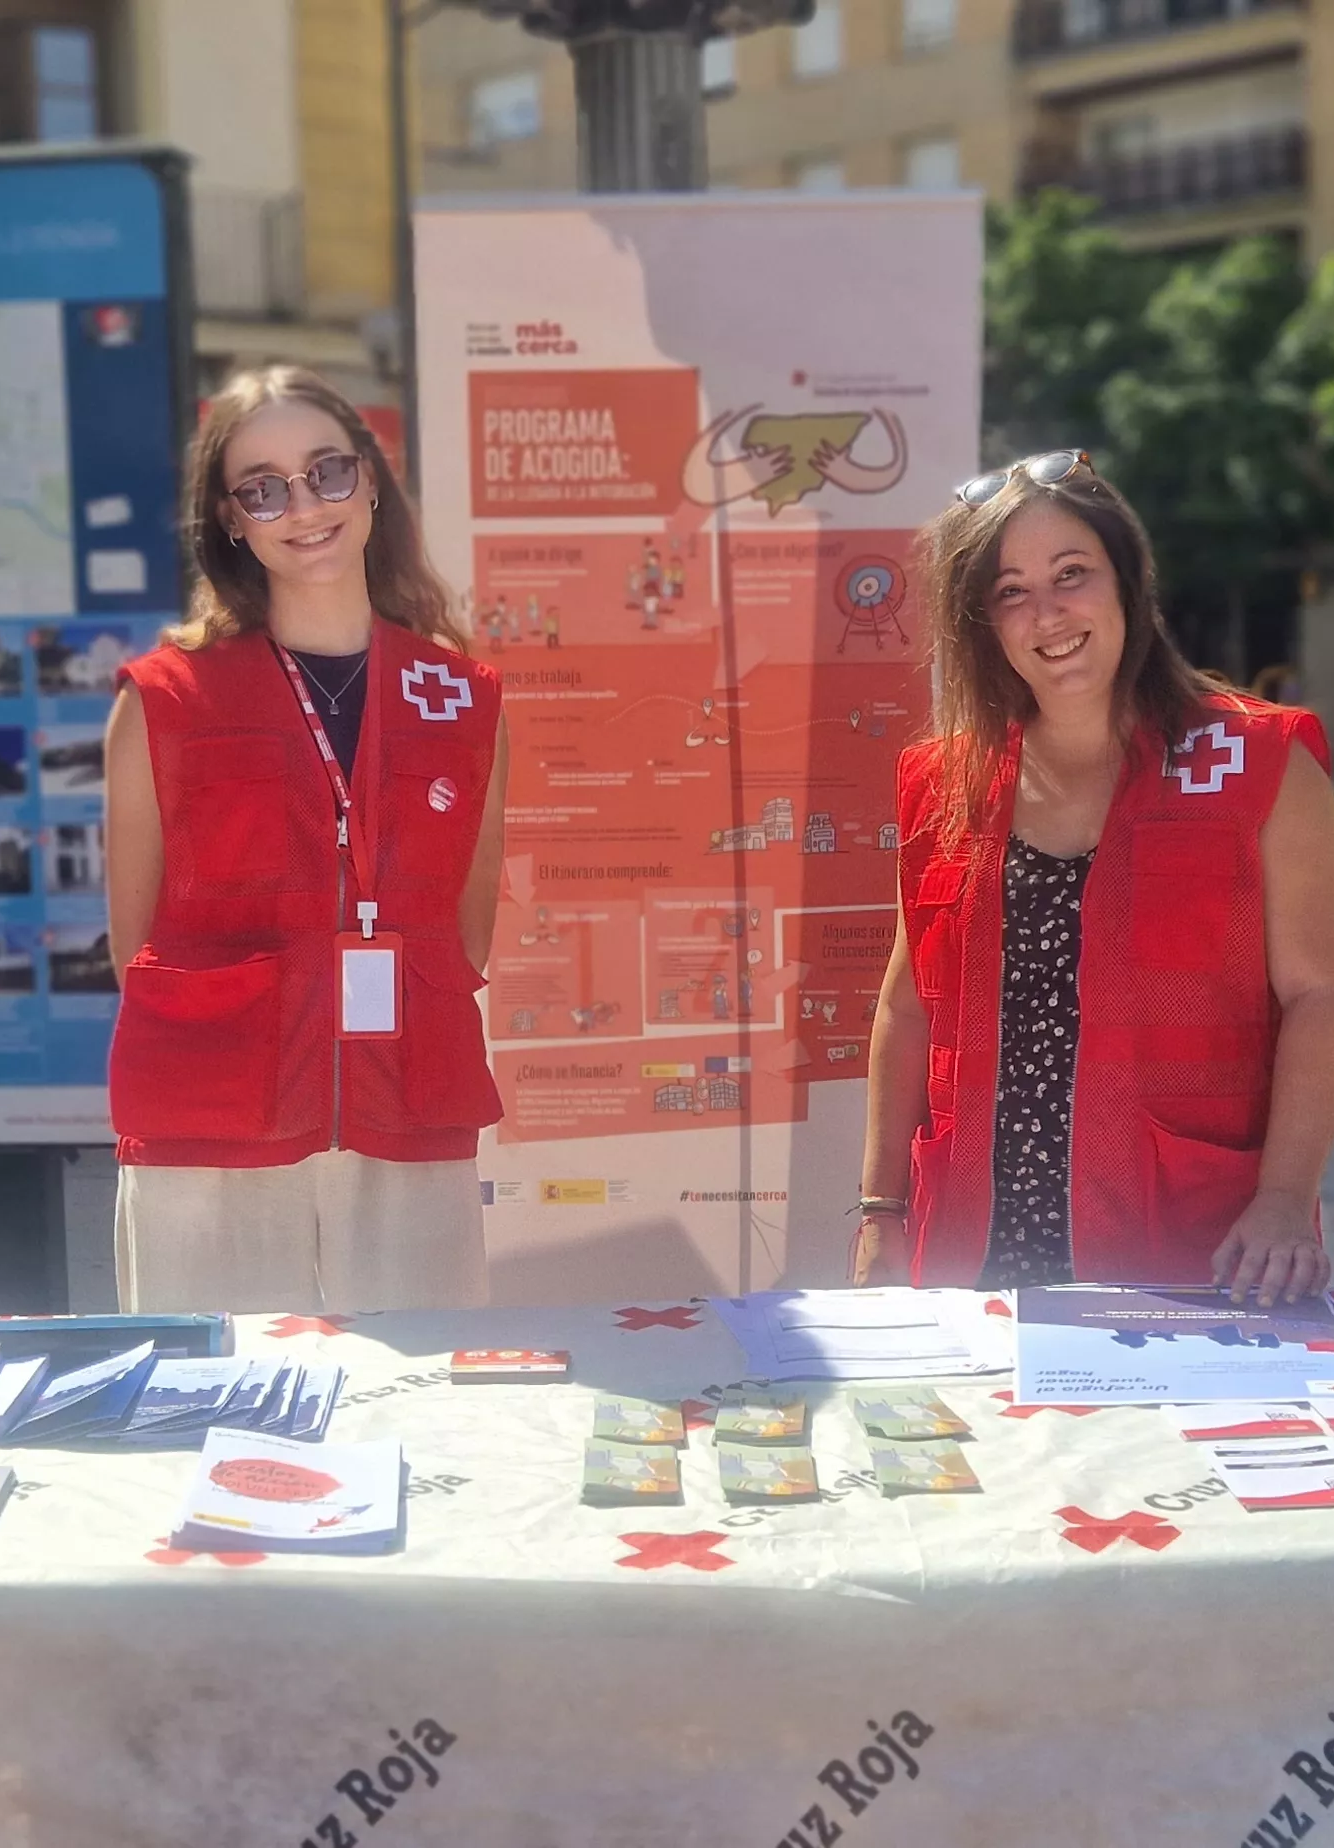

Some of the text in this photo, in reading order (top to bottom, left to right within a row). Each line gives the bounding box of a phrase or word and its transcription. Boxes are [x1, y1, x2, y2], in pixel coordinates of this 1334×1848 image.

[516, 320, 562, 338] más
[516, 340, 578, 355] cerca
[484, 408, 616, 443] PROGRAMA
[485, 447, 631, 480] DE ACOGIDA:
[525, 671, 537, 684] se
[540, 668, 581, 688] trabaja
[539, 861, 673, 881] El itinerario comprende:
[822, 922, 898, 943] Algunos servi
[823, 943, 893, 959] transversale
[516, 1064, 552, 1082] ¿Cómo
[570, 1063, 623, 1079] financia?
[1063, 1382, 1136, 1396] refugio
[404, 1473, 474, 1499] oja
[334, 1717, 458, 1827] Roja
[816, 1710, 935, 1818] Roja
